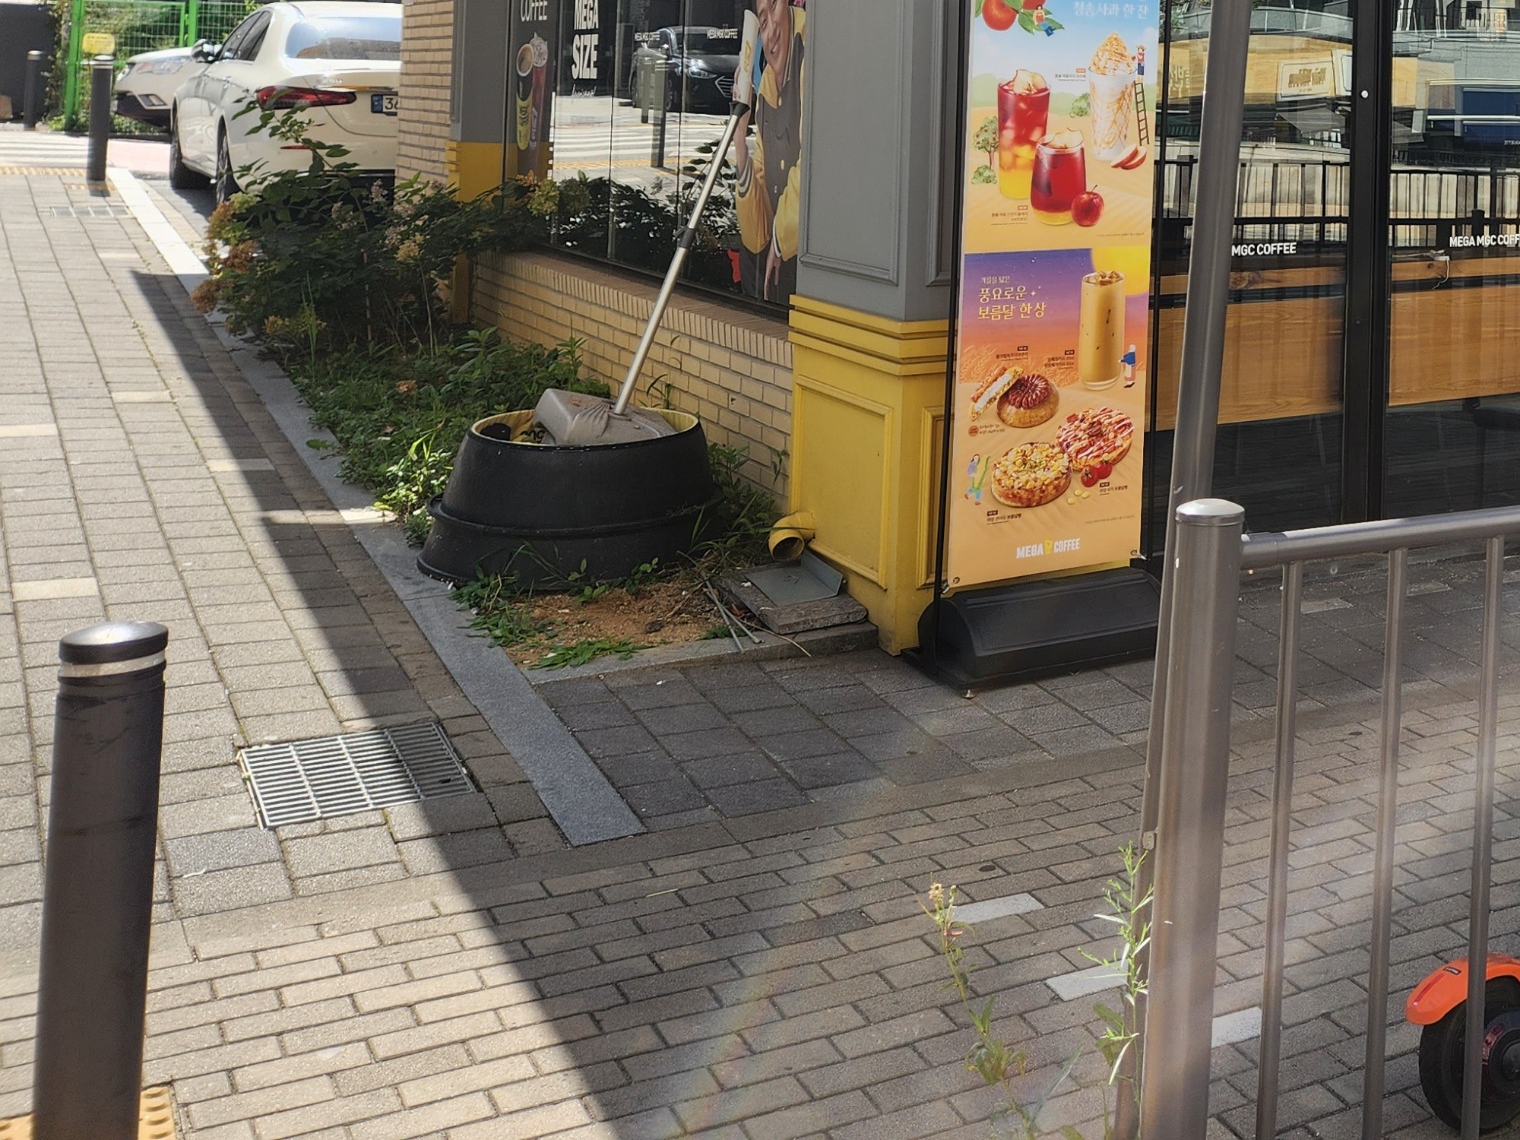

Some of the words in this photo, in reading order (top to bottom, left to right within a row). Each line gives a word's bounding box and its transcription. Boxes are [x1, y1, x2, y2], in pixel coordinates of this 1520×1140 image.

[571, 33, 599, 80] SIZE
[1231, 244, 1255, 257] MGC
[1256, 242, 1297, 256] COFFEE
[1450, 235, 1475, 248] MEGA
[1477, 234, 1497, 247] MGC
[979, 285, 1027, 303] 풍요로운
[978, 304, 1015, 321] 보름달
[1016, 543, 1043, 559] MEGA
[1053, 538, 1081, 554] COFFEE
